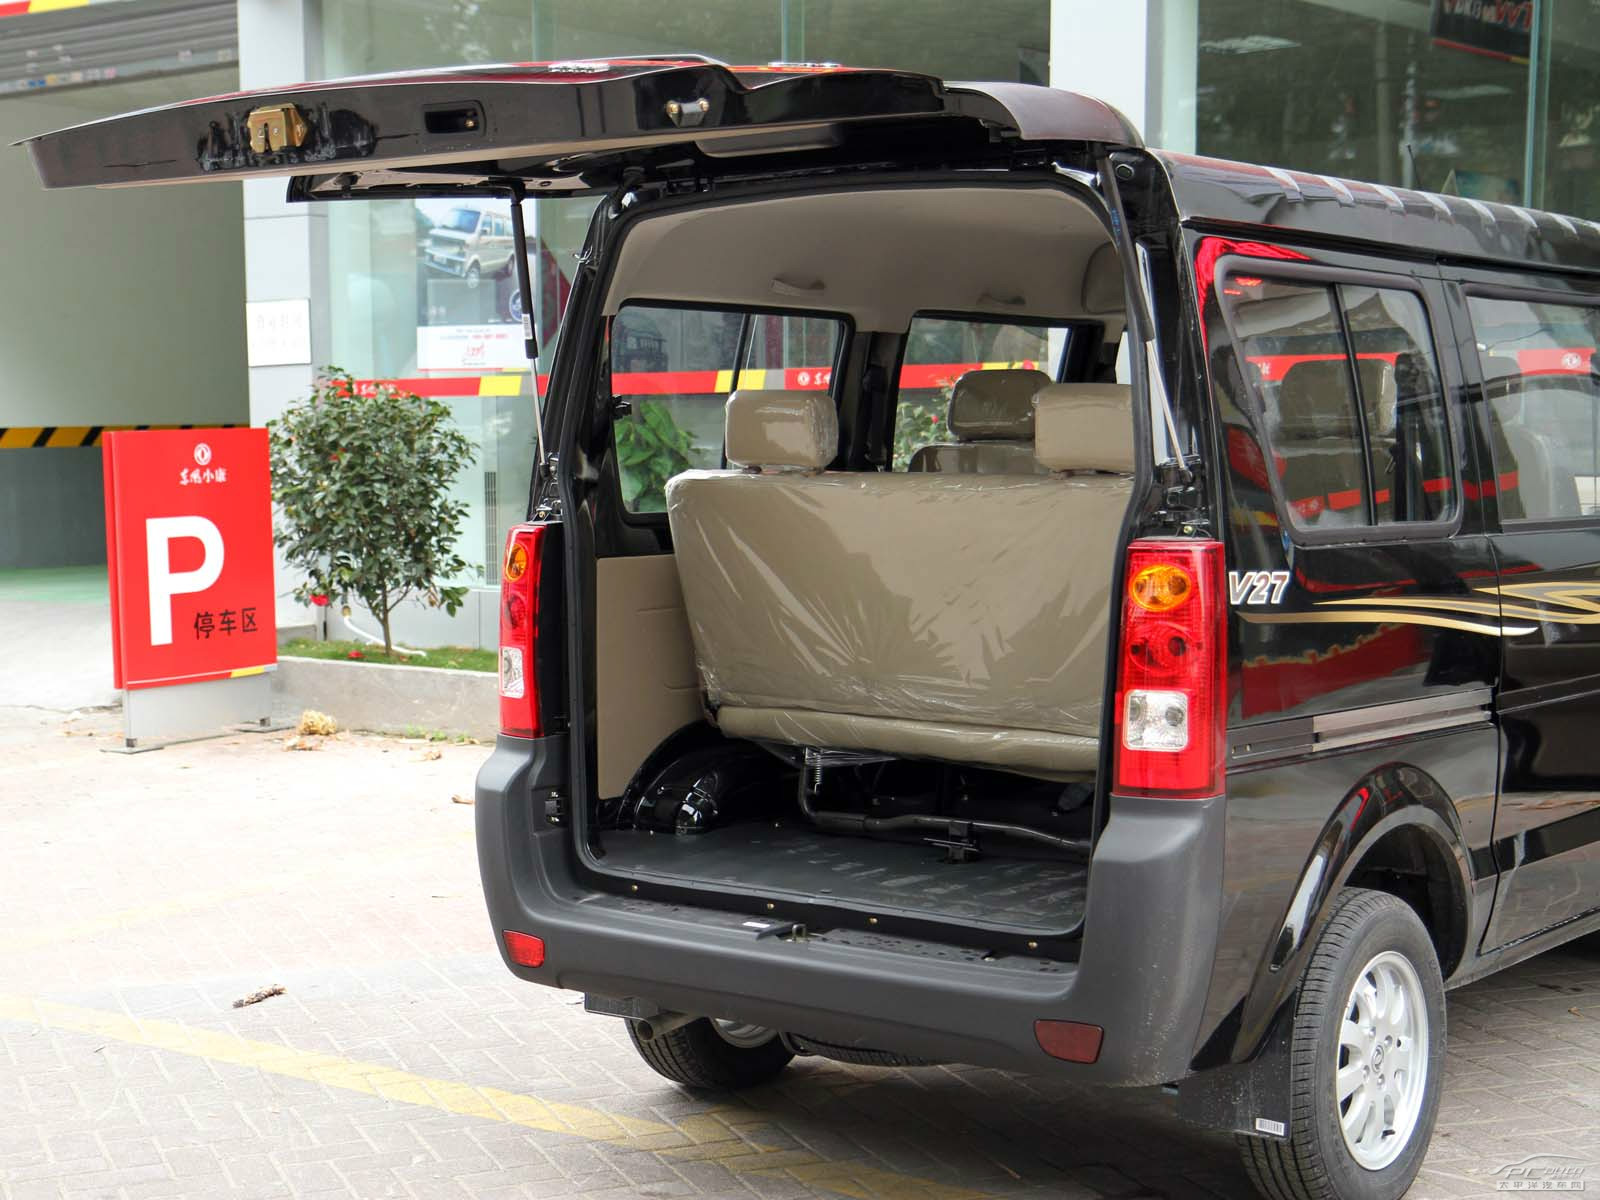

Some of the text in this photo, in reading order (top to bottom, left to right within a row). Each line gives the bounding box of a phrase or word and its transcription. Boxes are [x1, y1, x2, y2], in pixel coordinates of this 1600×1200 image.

[145, 515, 225, 646] P
[1228, 570, 1290, 605] V27
[193, 607, 258, 640] 停车区
